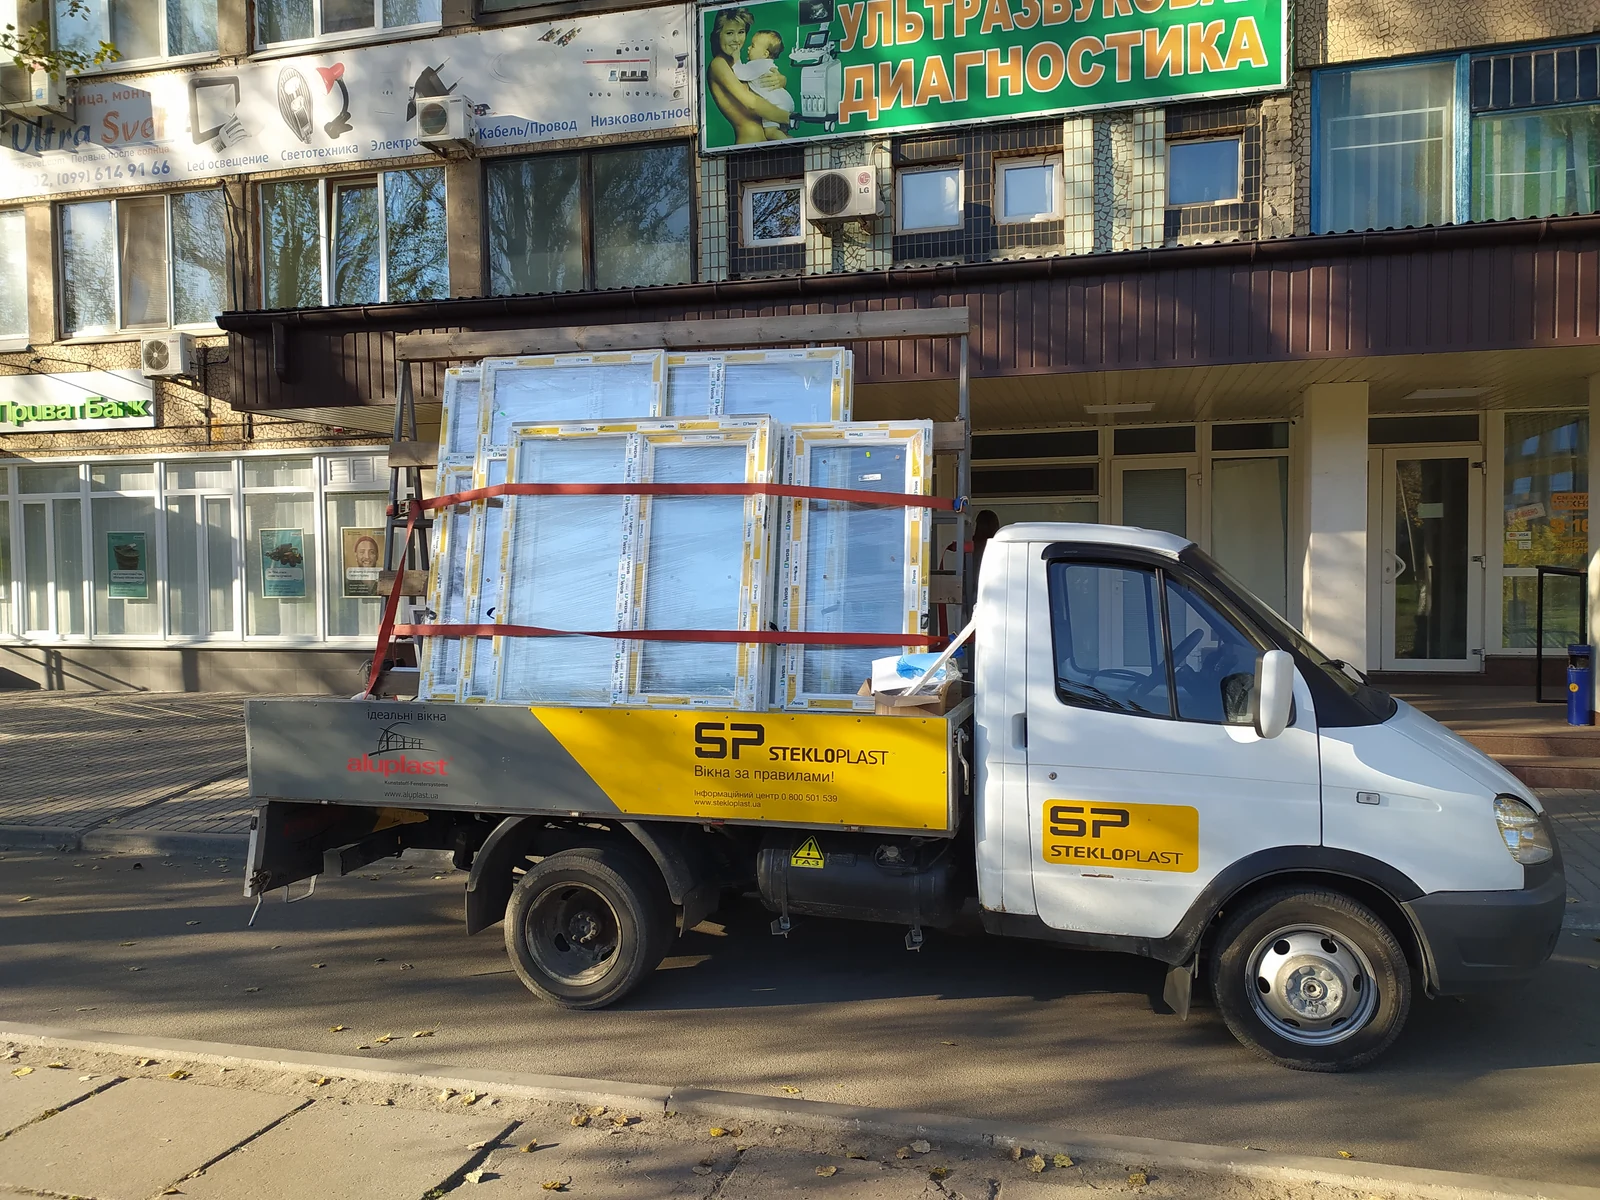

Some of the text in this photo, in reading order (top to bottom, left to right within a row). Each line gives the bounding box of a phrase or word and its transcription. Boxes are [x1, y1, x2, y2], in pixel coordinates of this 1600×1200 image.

[838, 16, 1269, 125] ДИАГНОСТИКА
[70, 93, 108, 107] ица,
[591, 107, 691, 128] Низковольтное
[11, 122, 91, 153] Ultra
[479, 118, 578, 140] Кабель/Провод
[72, 154, 106, 165] Первые
[108, 150, 135, 159] после
[136, 146, 170, 158] солнца
[280, 143, 359, 161] Светотехника
[57, 170, 91, 186] (099)
[95, 164, 124, 182] 614
[127, 163, 146, 178] 91
[151, 159, 171, 175] 66
[187, 154, 269, 172] Led освещение
[859, 186, 870, 194] LG
[0, 396, 150, 427] ПриватБанк
[367, 709, 447, 721] ідеальні вікна
[694, 722, 889, 766] SP STEKLOPLAST
[346, 753, 449, 778] aluplast
[694, 765, 835, 783] Вікна за правилами!
[384, 790, 439, 800] www.aluplast.ua
[694, 789, 754, 799] Інформаційний
[755, 791, 780, 801] центр
[788, 793, 804, 801] 800
[805, 794, 820, 802] 501
[822, 794, 838, 802] 539
[694, 799, 762, 808] www.stekloplast.ua
[1050, 806, 1129, 838] SP
[1051, 845, 1184, 865] STEKLOPLAST
